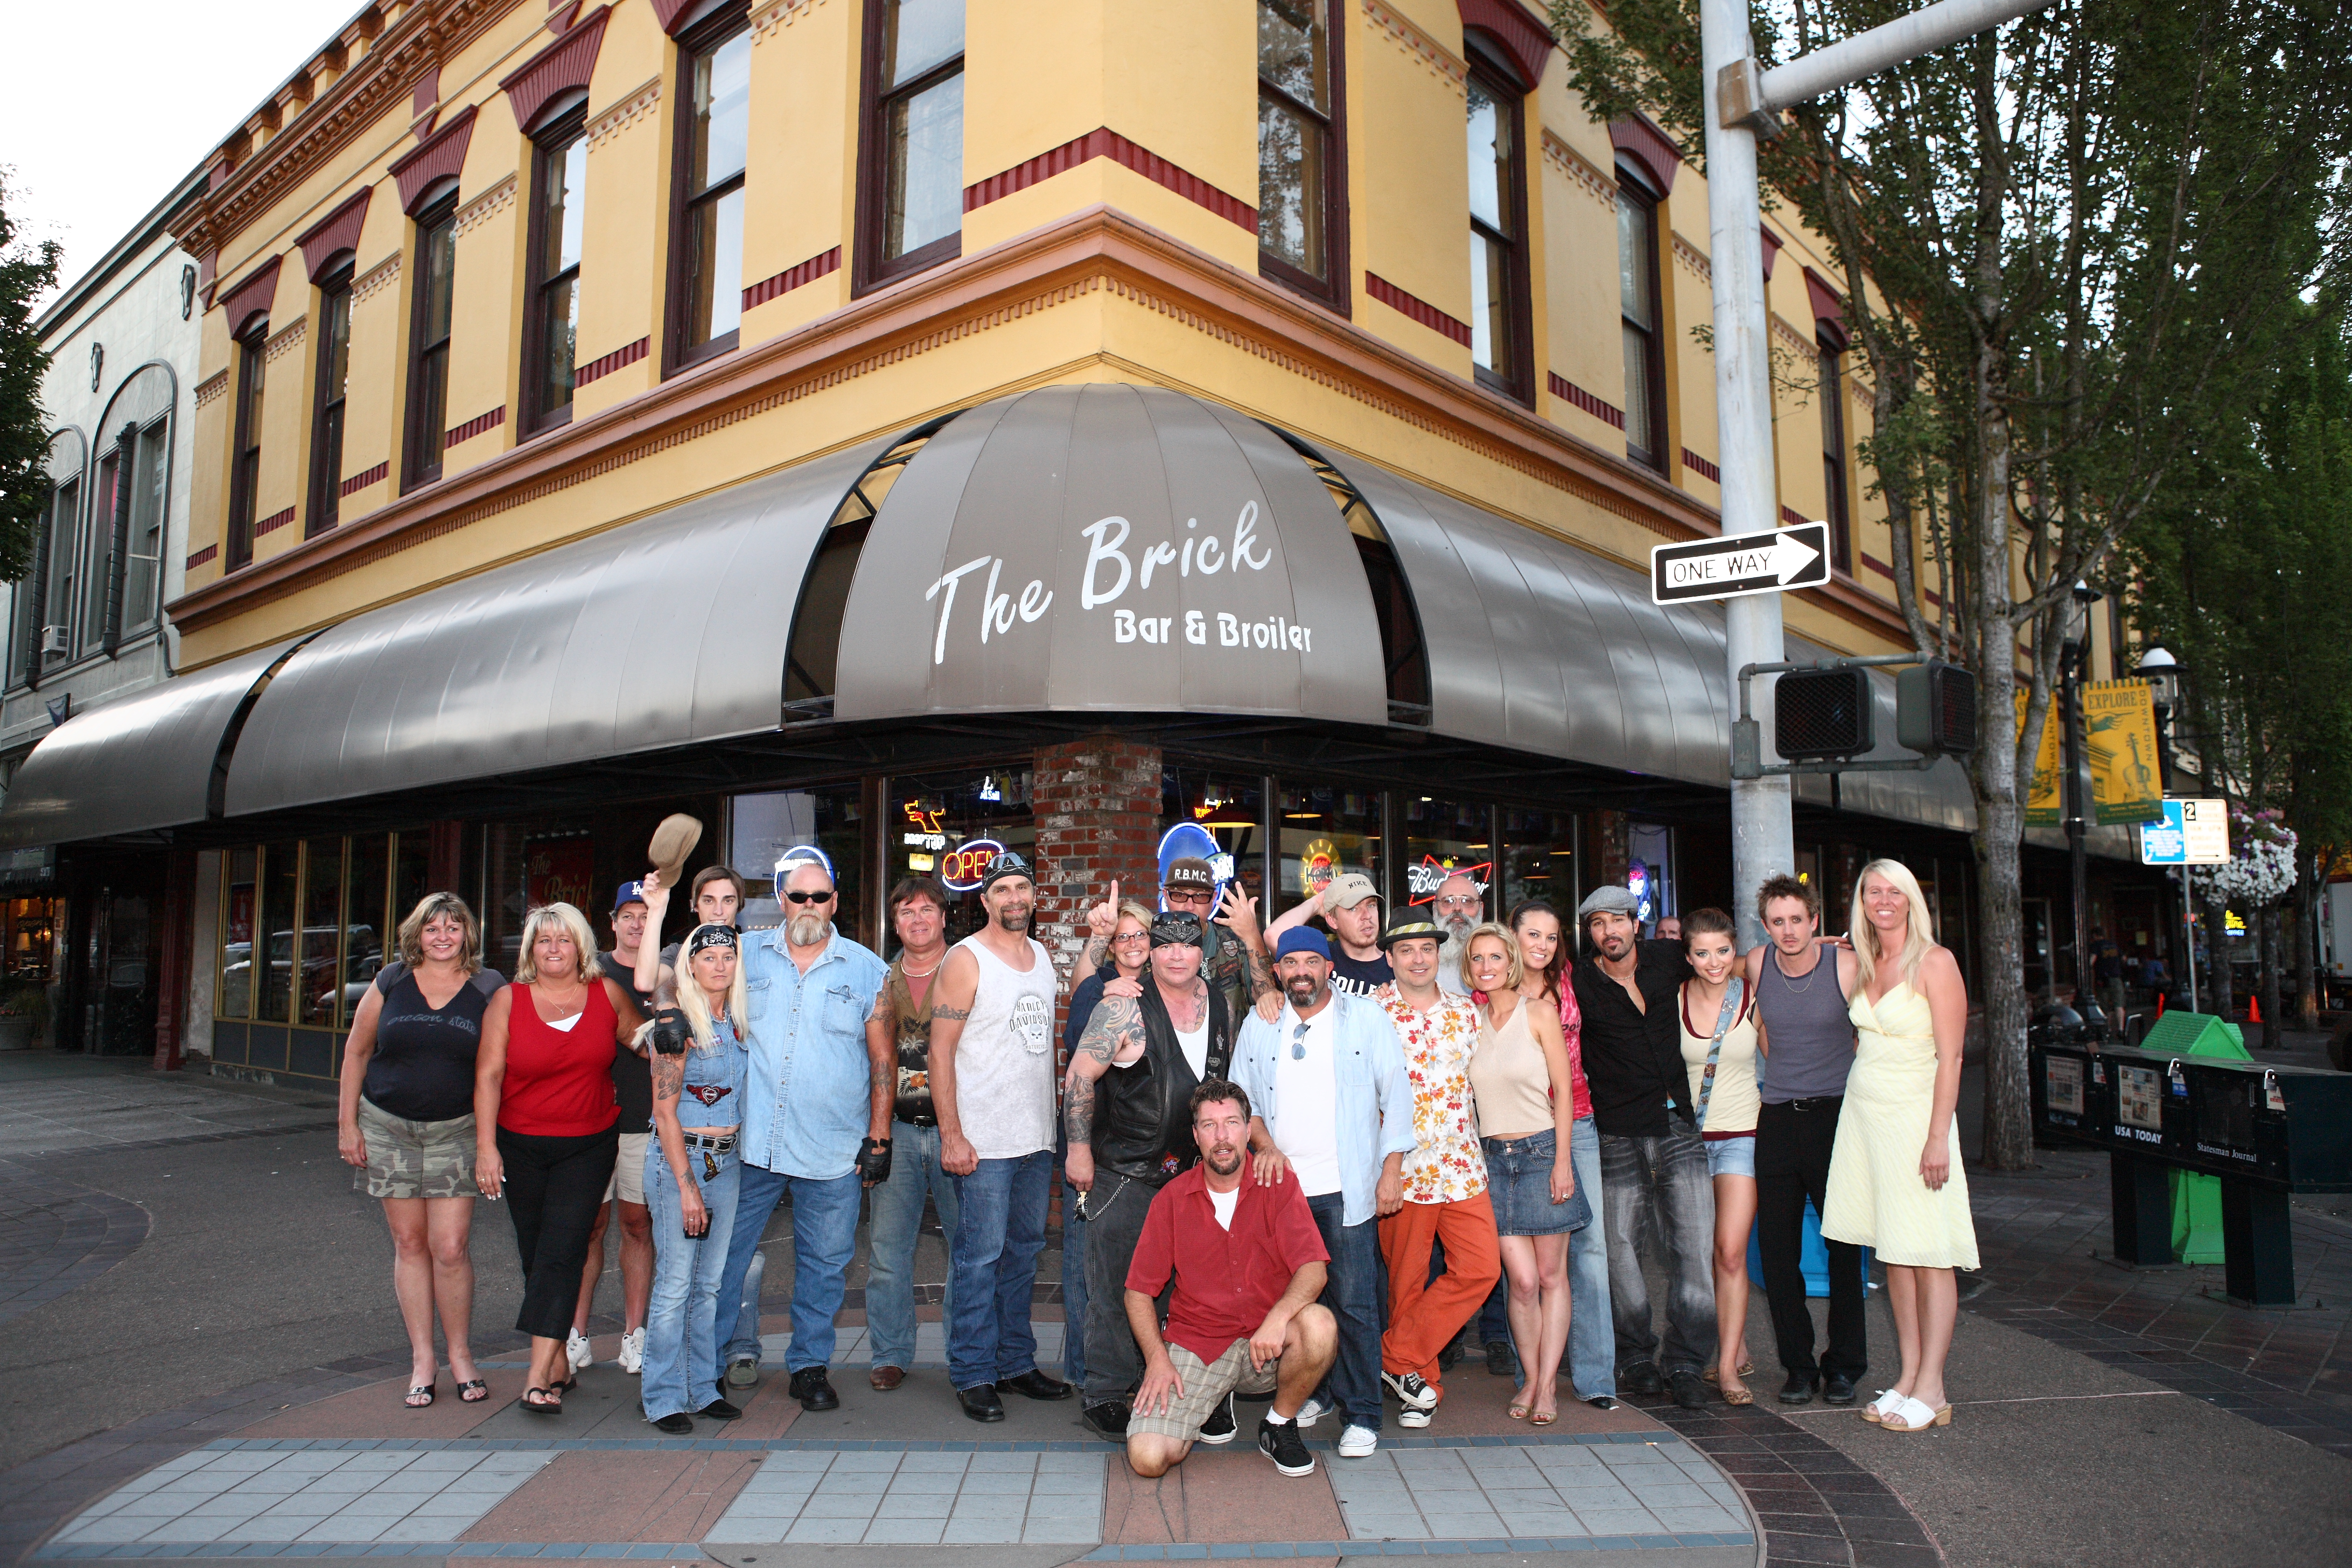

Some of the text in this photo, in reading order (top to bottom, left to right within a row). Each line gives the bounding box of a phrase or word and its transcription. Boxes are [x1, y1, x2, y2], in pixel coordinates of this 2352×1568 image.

[1674, 552, 1772, 582] ONE WAY
[926, 500, 1271, 664] The Brick
[1114, 609, 1312, 653] Bar & Broiler
[2088, 691, 2138, 710] EXPLORE
[2139, 690, 2153, 761] DOWNTOWN
[2185, 803, 2195, 820] 2
[1175, 869, 1208, 883] R.B.M.C.
[1348, 881, 1368, 889] NIKE
[632, 882, 643, 895] LA
[1017, 998, 1044, 1012] HARLEY
[449, 1015, 478, 1035] state
[1010, 1014, 1052, 1033] DAVIDSON
[2115, 1125, 2162, 1144] USA TODAY
[2197, 1142, 2257, 1163] Statesman Journal
